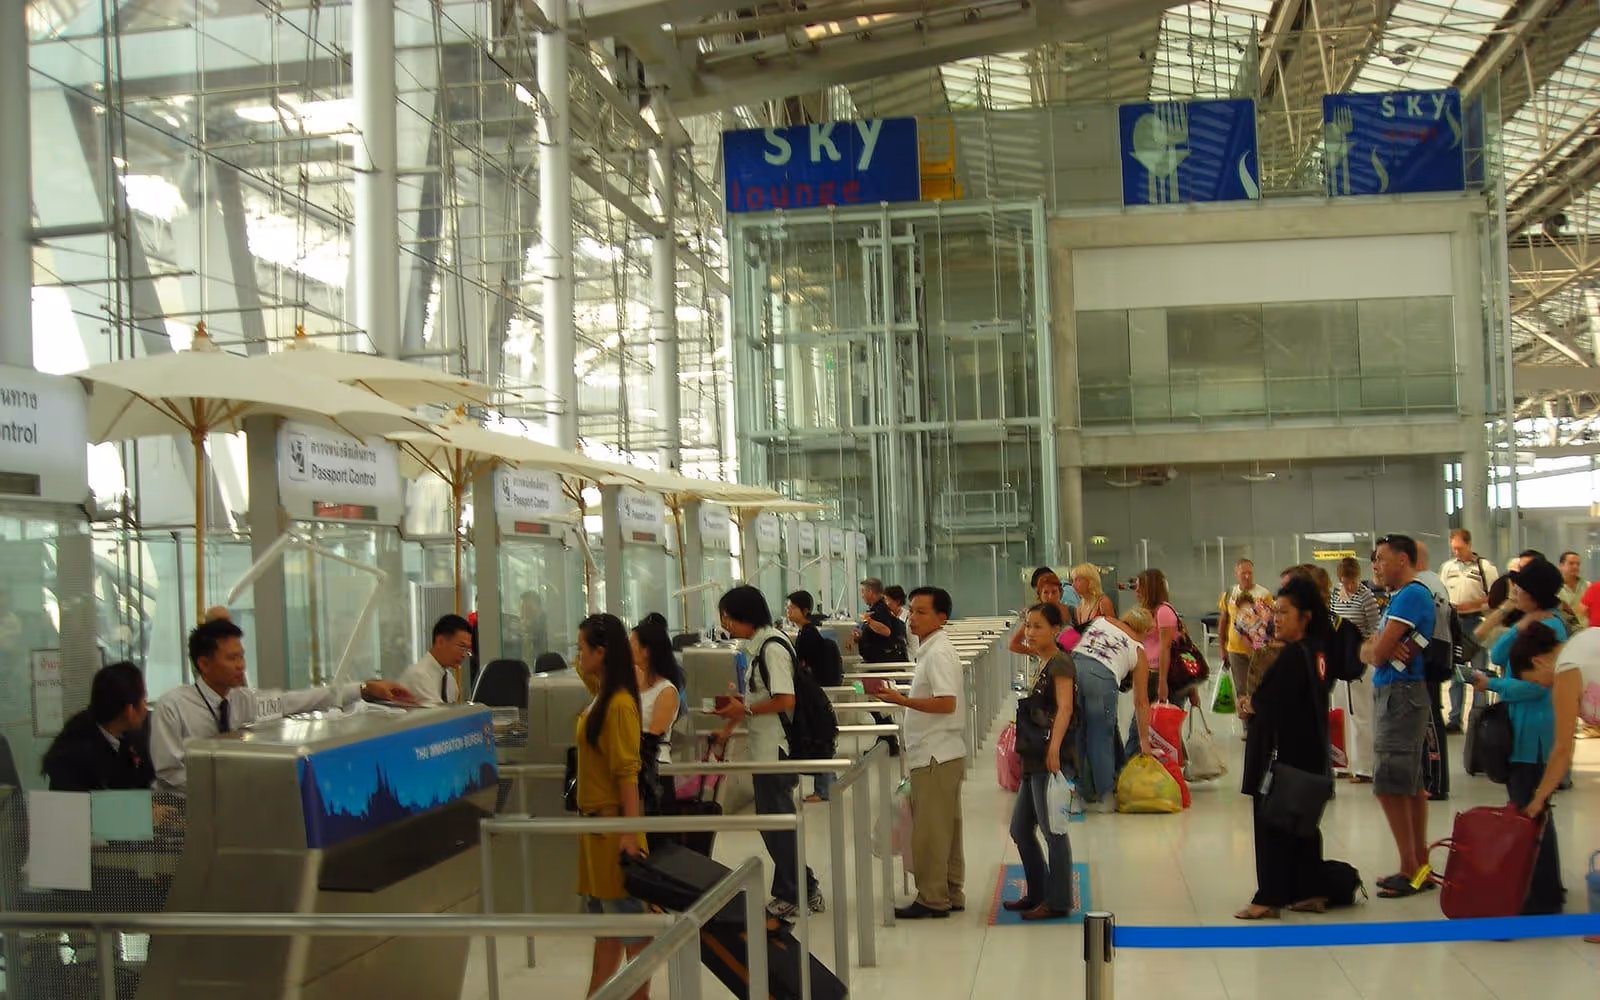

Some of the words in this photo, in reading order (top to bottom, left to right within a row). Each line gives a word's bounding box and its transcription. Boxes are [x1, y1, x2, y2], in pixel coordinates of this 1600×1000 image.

[0, 421, 37, 445] ntrol
[312, 463, 347, 485] Passport
[349, 468, 376, 487] Control
